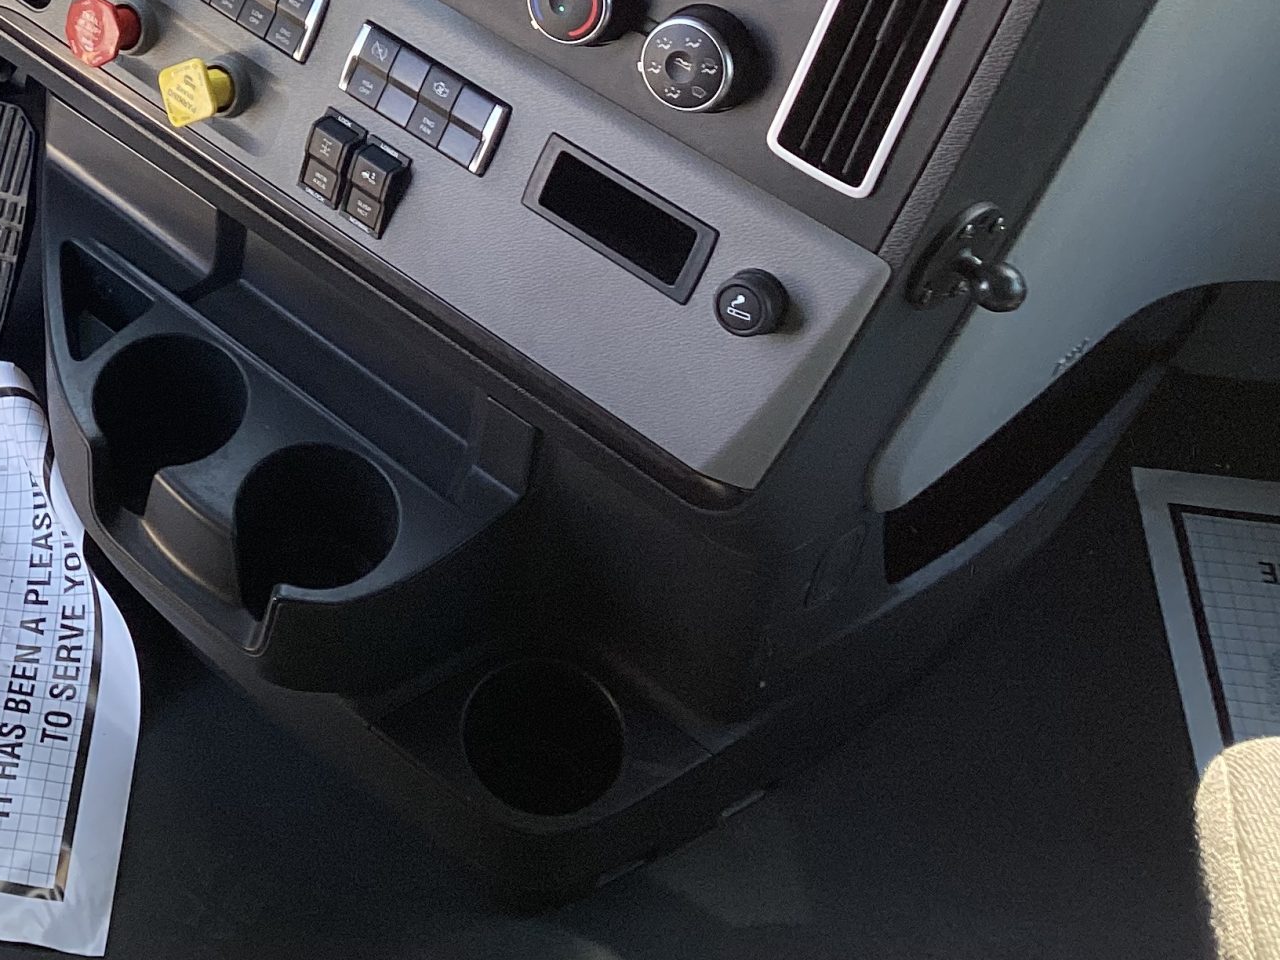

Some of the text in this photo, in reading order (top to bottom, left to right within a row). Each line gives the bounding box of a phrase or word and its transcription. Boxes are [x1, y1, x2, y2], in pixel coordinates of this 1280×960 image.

[337, 115, 353, 128] LOCK
[379, 142, 399, 158] LOWER
[19, 616, 47, 636] A
[48, 603, 87, 702] SERVE
[3, 643, 42, 715] BEEN
[39, 709, 73, 744] TO
